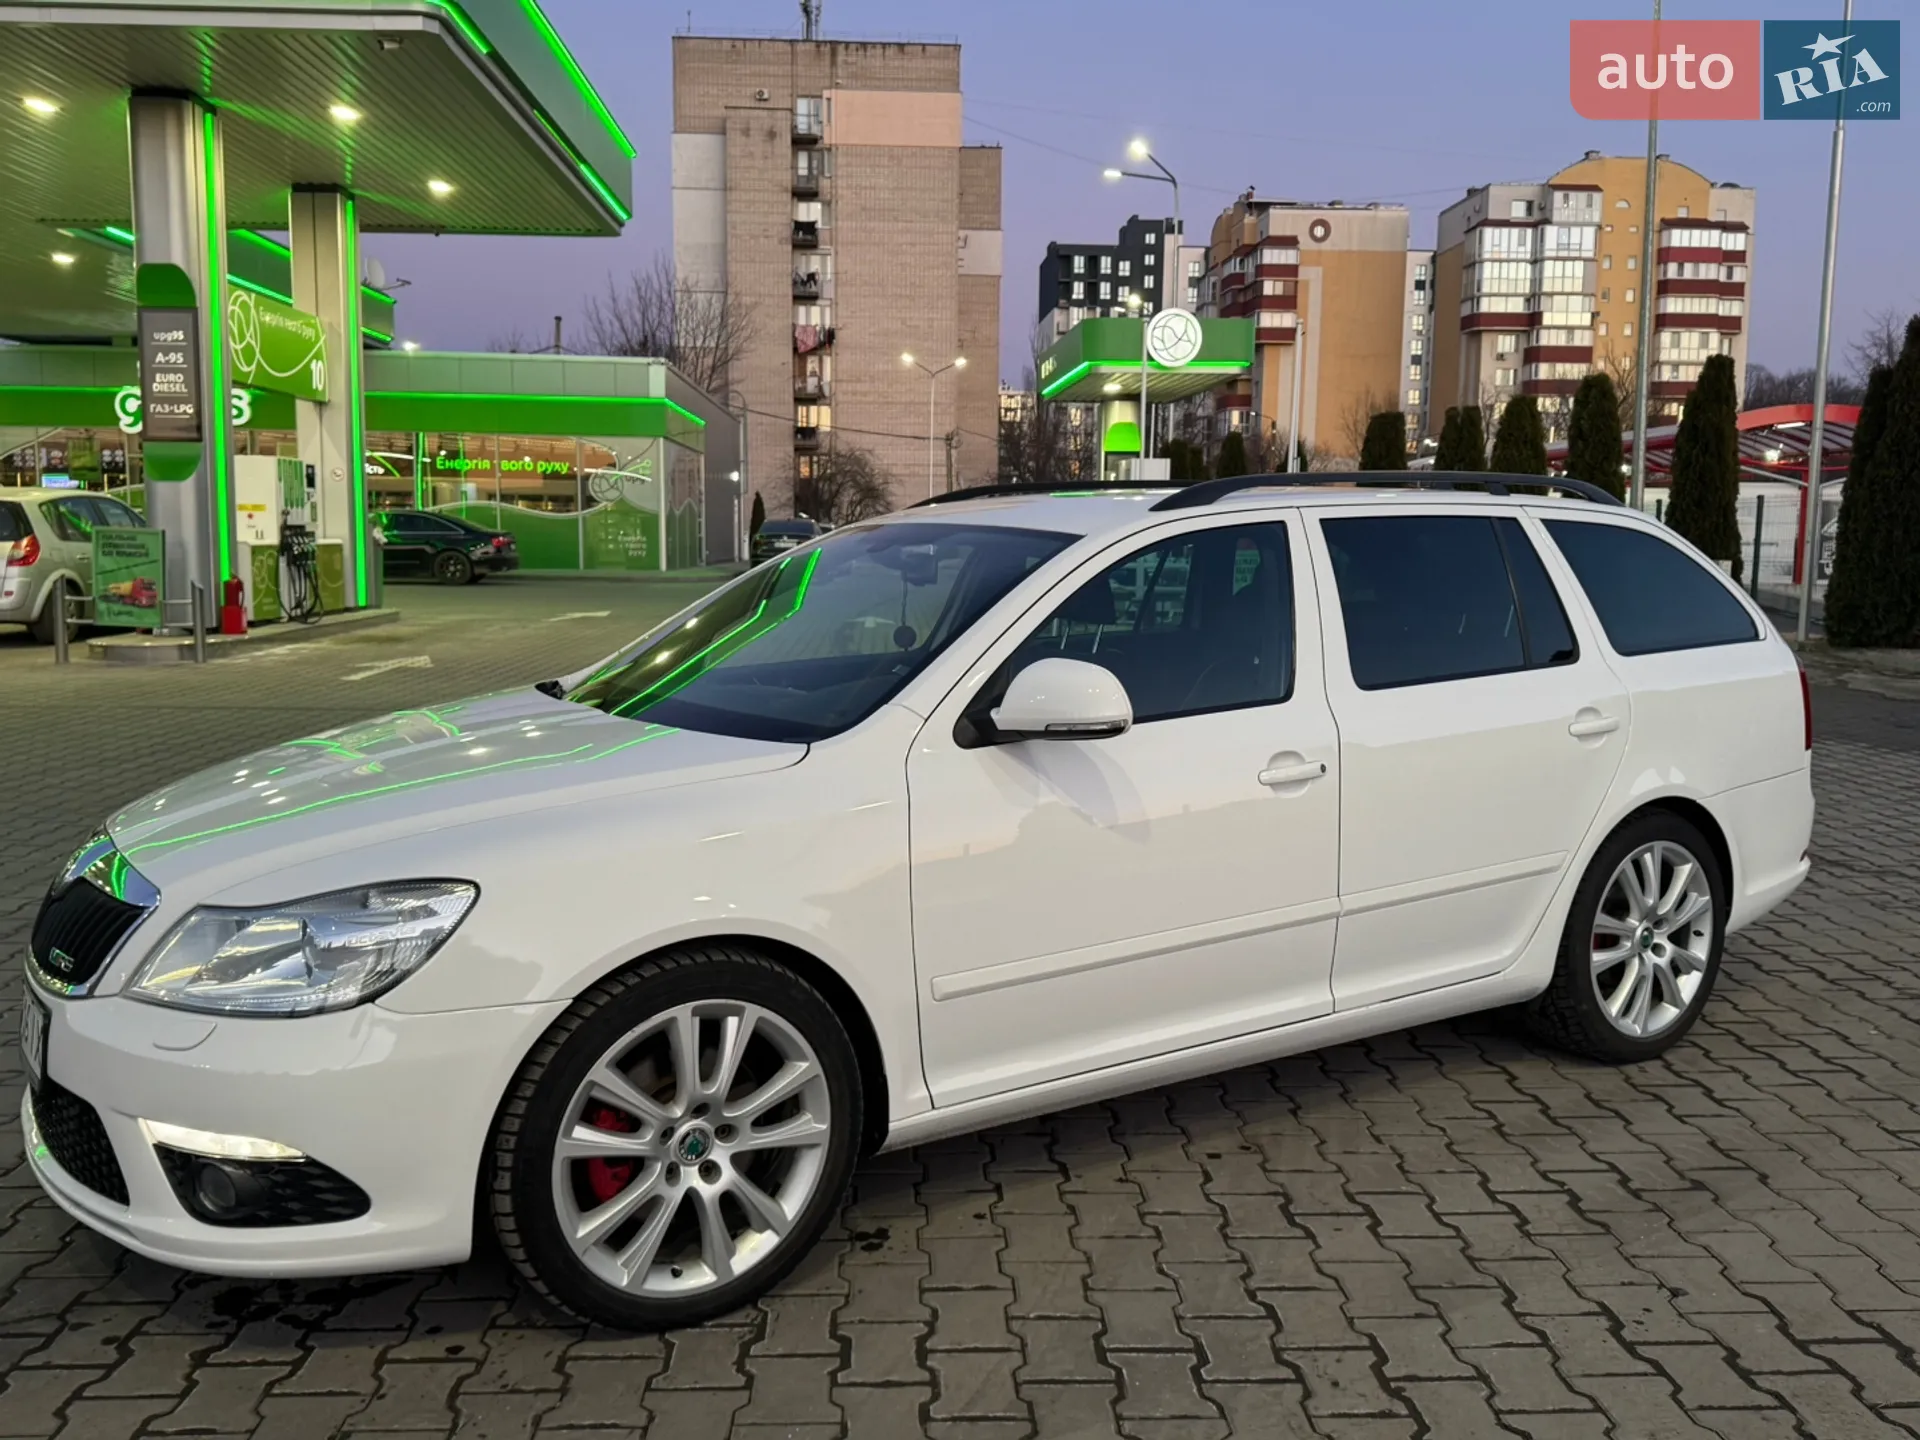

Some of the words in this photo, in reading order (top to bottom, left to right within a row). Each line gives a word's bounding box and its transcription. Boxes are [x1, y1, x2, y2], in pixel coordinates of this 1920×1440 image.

[153, 330, 185, 342] upg95
[155, 373, 184, 383] EURO
[311, 358, 324, 391] 10
[152, 383, 188, 392] DIESEL
[537, 460, 570, 475] руху
